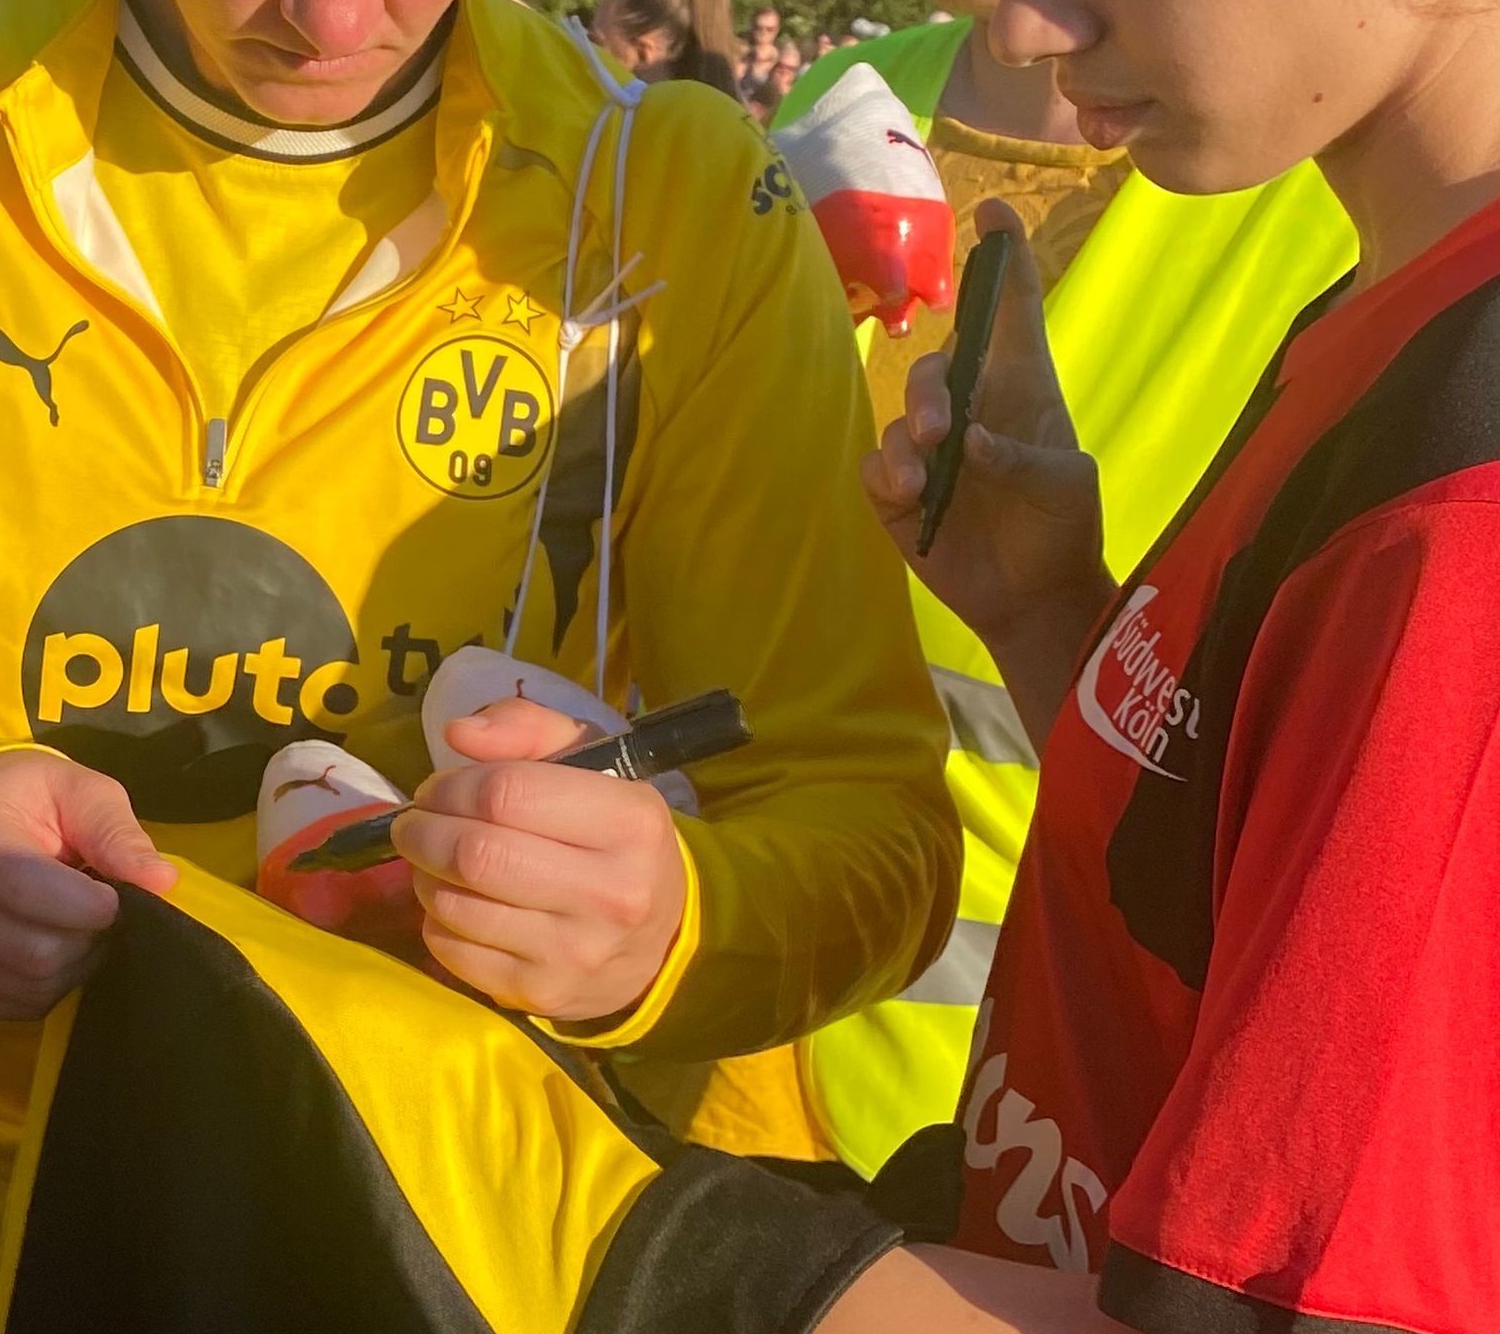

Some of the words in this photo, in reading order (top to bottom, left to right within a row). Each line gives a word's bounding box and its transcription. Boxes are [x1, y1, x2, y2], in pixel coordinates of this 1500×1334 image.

[416, 349, 540, 457] BVB
[448, 450, 493, 487] 09
[37, 623, 364, 734] pluto
[1113, 686, 1170, 763] Köln
